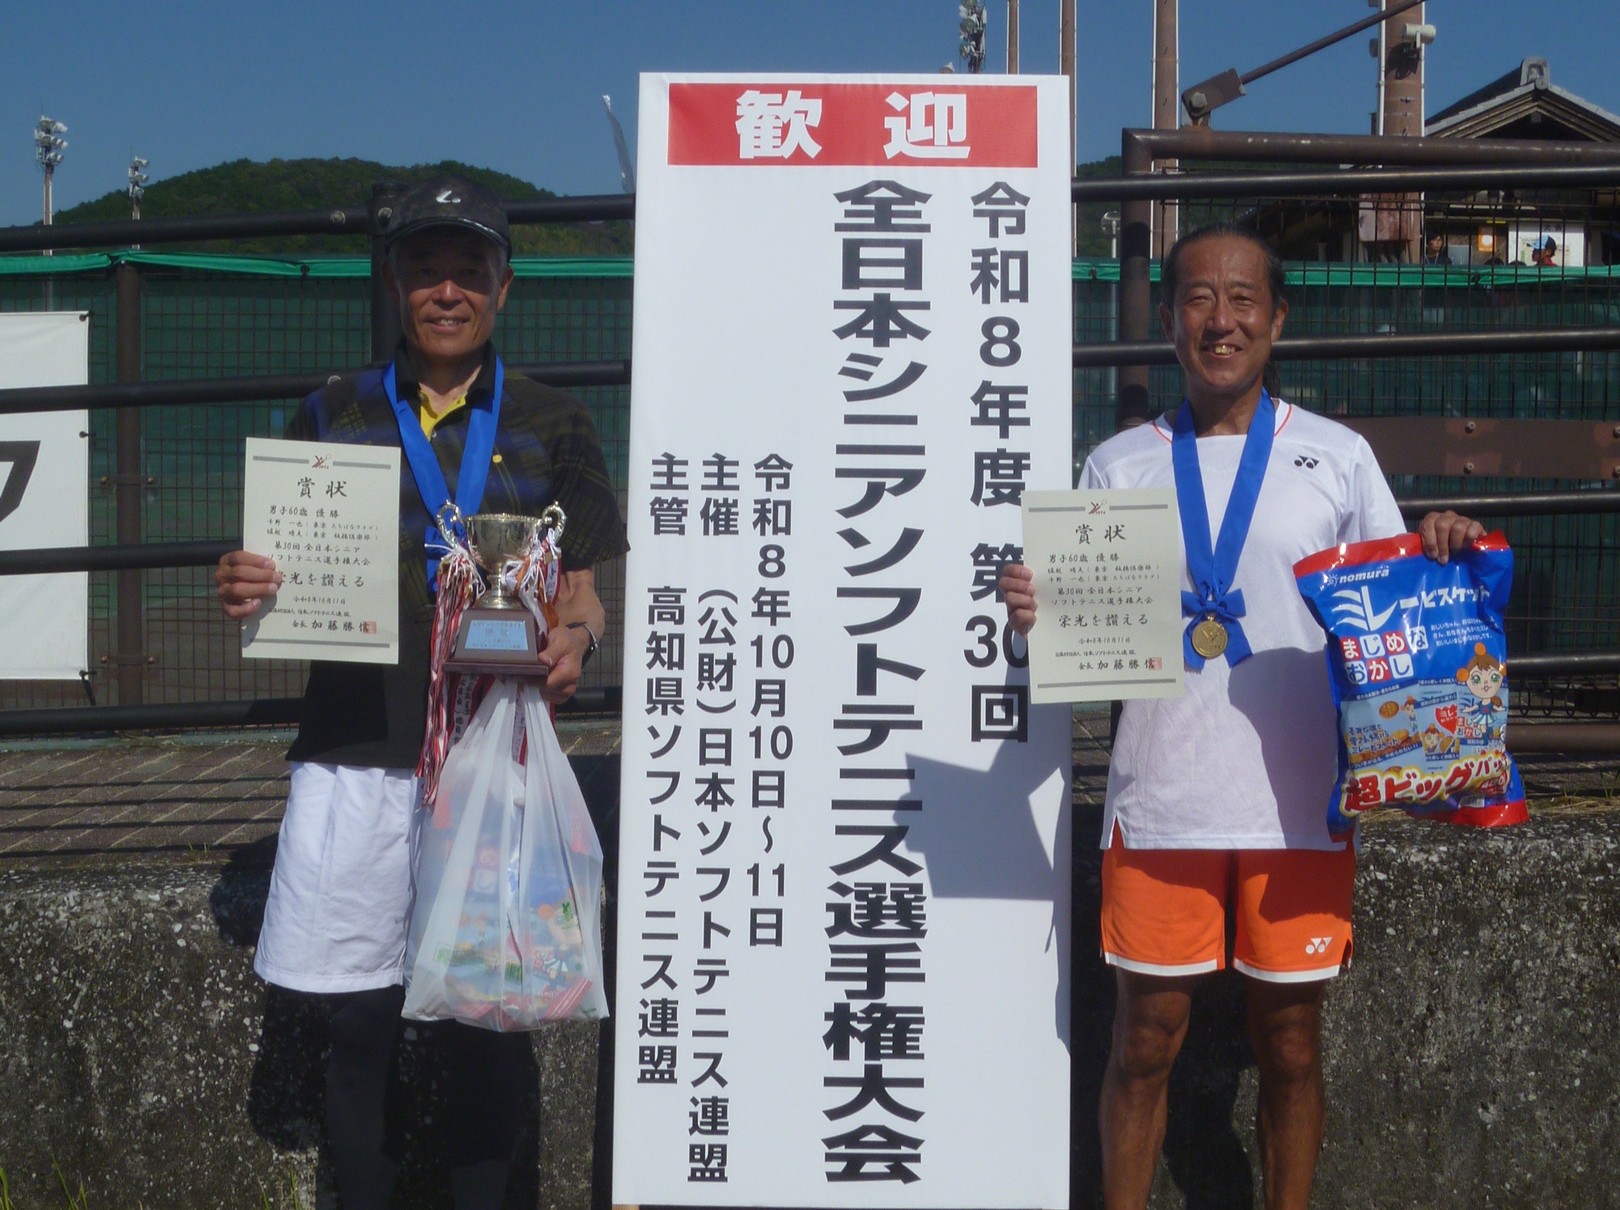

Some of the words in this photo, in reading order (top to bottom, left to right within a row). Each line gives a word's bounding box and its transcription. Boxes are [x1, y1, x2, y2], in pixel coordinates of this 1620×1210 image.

[735, 89, 971, 160] 歓迎
[970, 181, 1031, 507] 令和8年度
[297, 476, 348, 499] 賞状
[649, 452, 689, 536] 主管
[699, 453, 740, 536] 主催
[1075, 523, 1127, 545] 賞状
[1339, 567, 1390, 584] nomura
[822, 179, 933, 1184] 全日本シニアソフトテニス選手権大会
[637, 586, 687, 1084] 高知県ソフトテニス連盟
[687, 588, 740, 1183] （公財）日本ソフトテニス連盟
